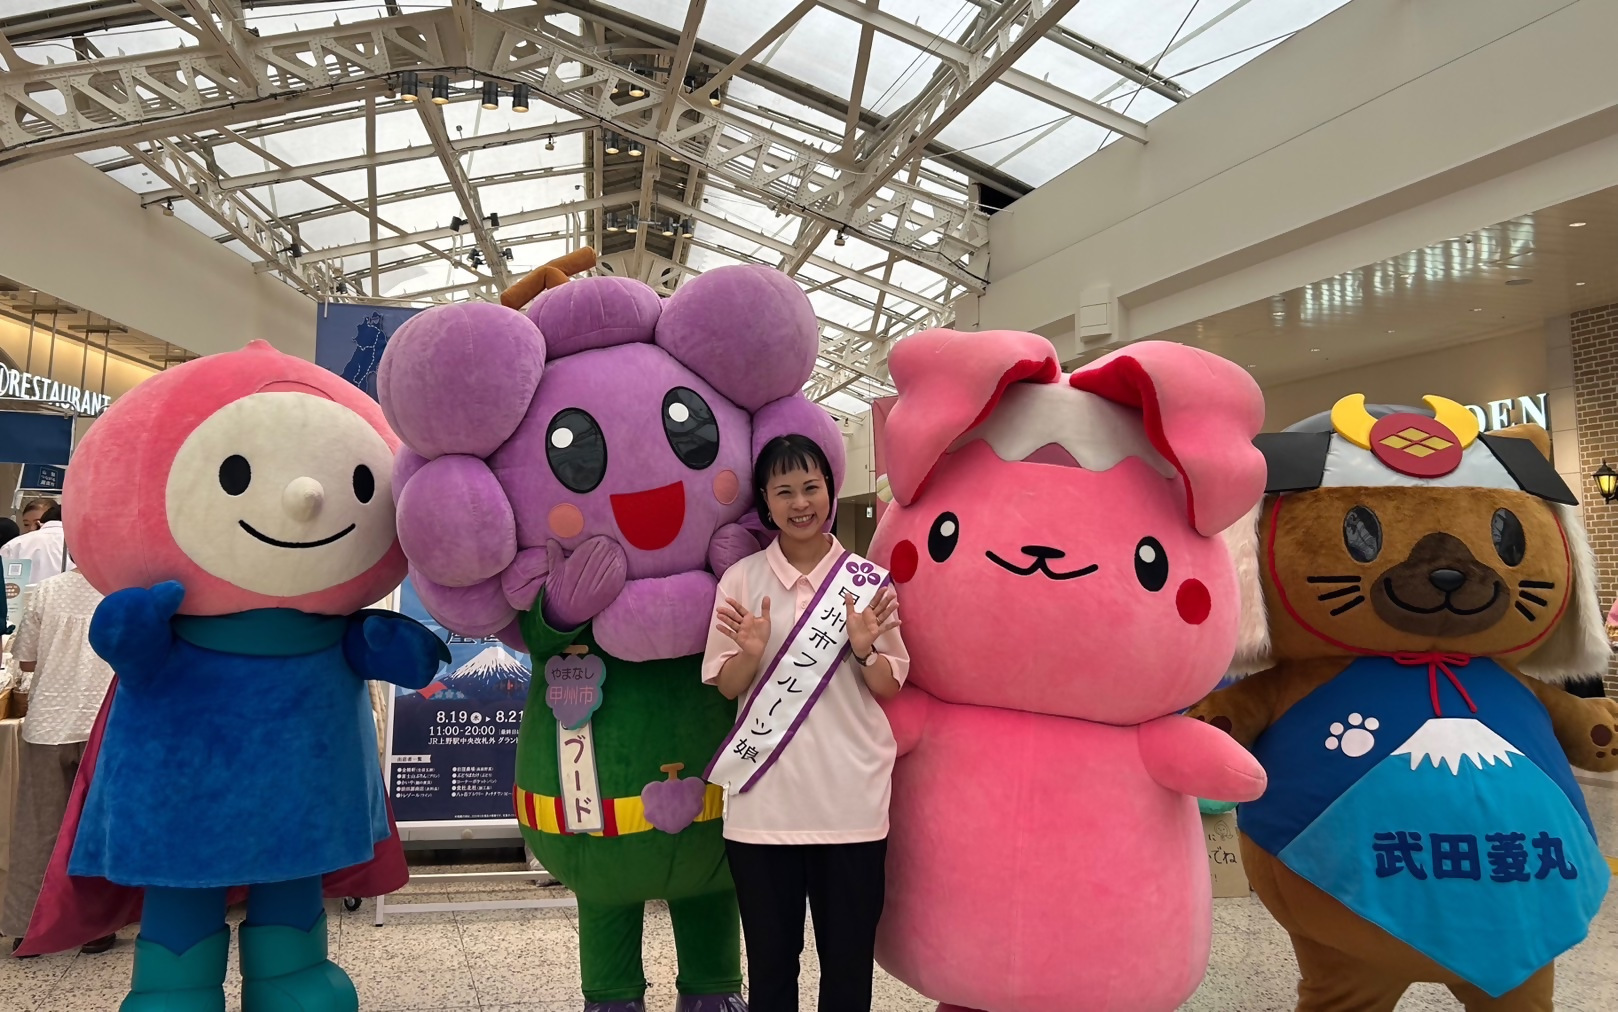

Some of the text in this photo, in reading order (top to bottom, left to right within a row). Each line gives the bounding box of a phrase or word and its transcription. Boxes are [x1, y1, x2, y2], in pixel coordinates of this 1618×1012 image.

[8, 369, 111, 416] RESTAURANT
[551, 667, 595, 681] やまなし
[549, 686, 594, 705] 甲州市
[436, 710, 468, 723] 8.19
[429, 725, 496, 736] 11:00-20:00
[1372, 831, 1578, 883] 武田菱丸
